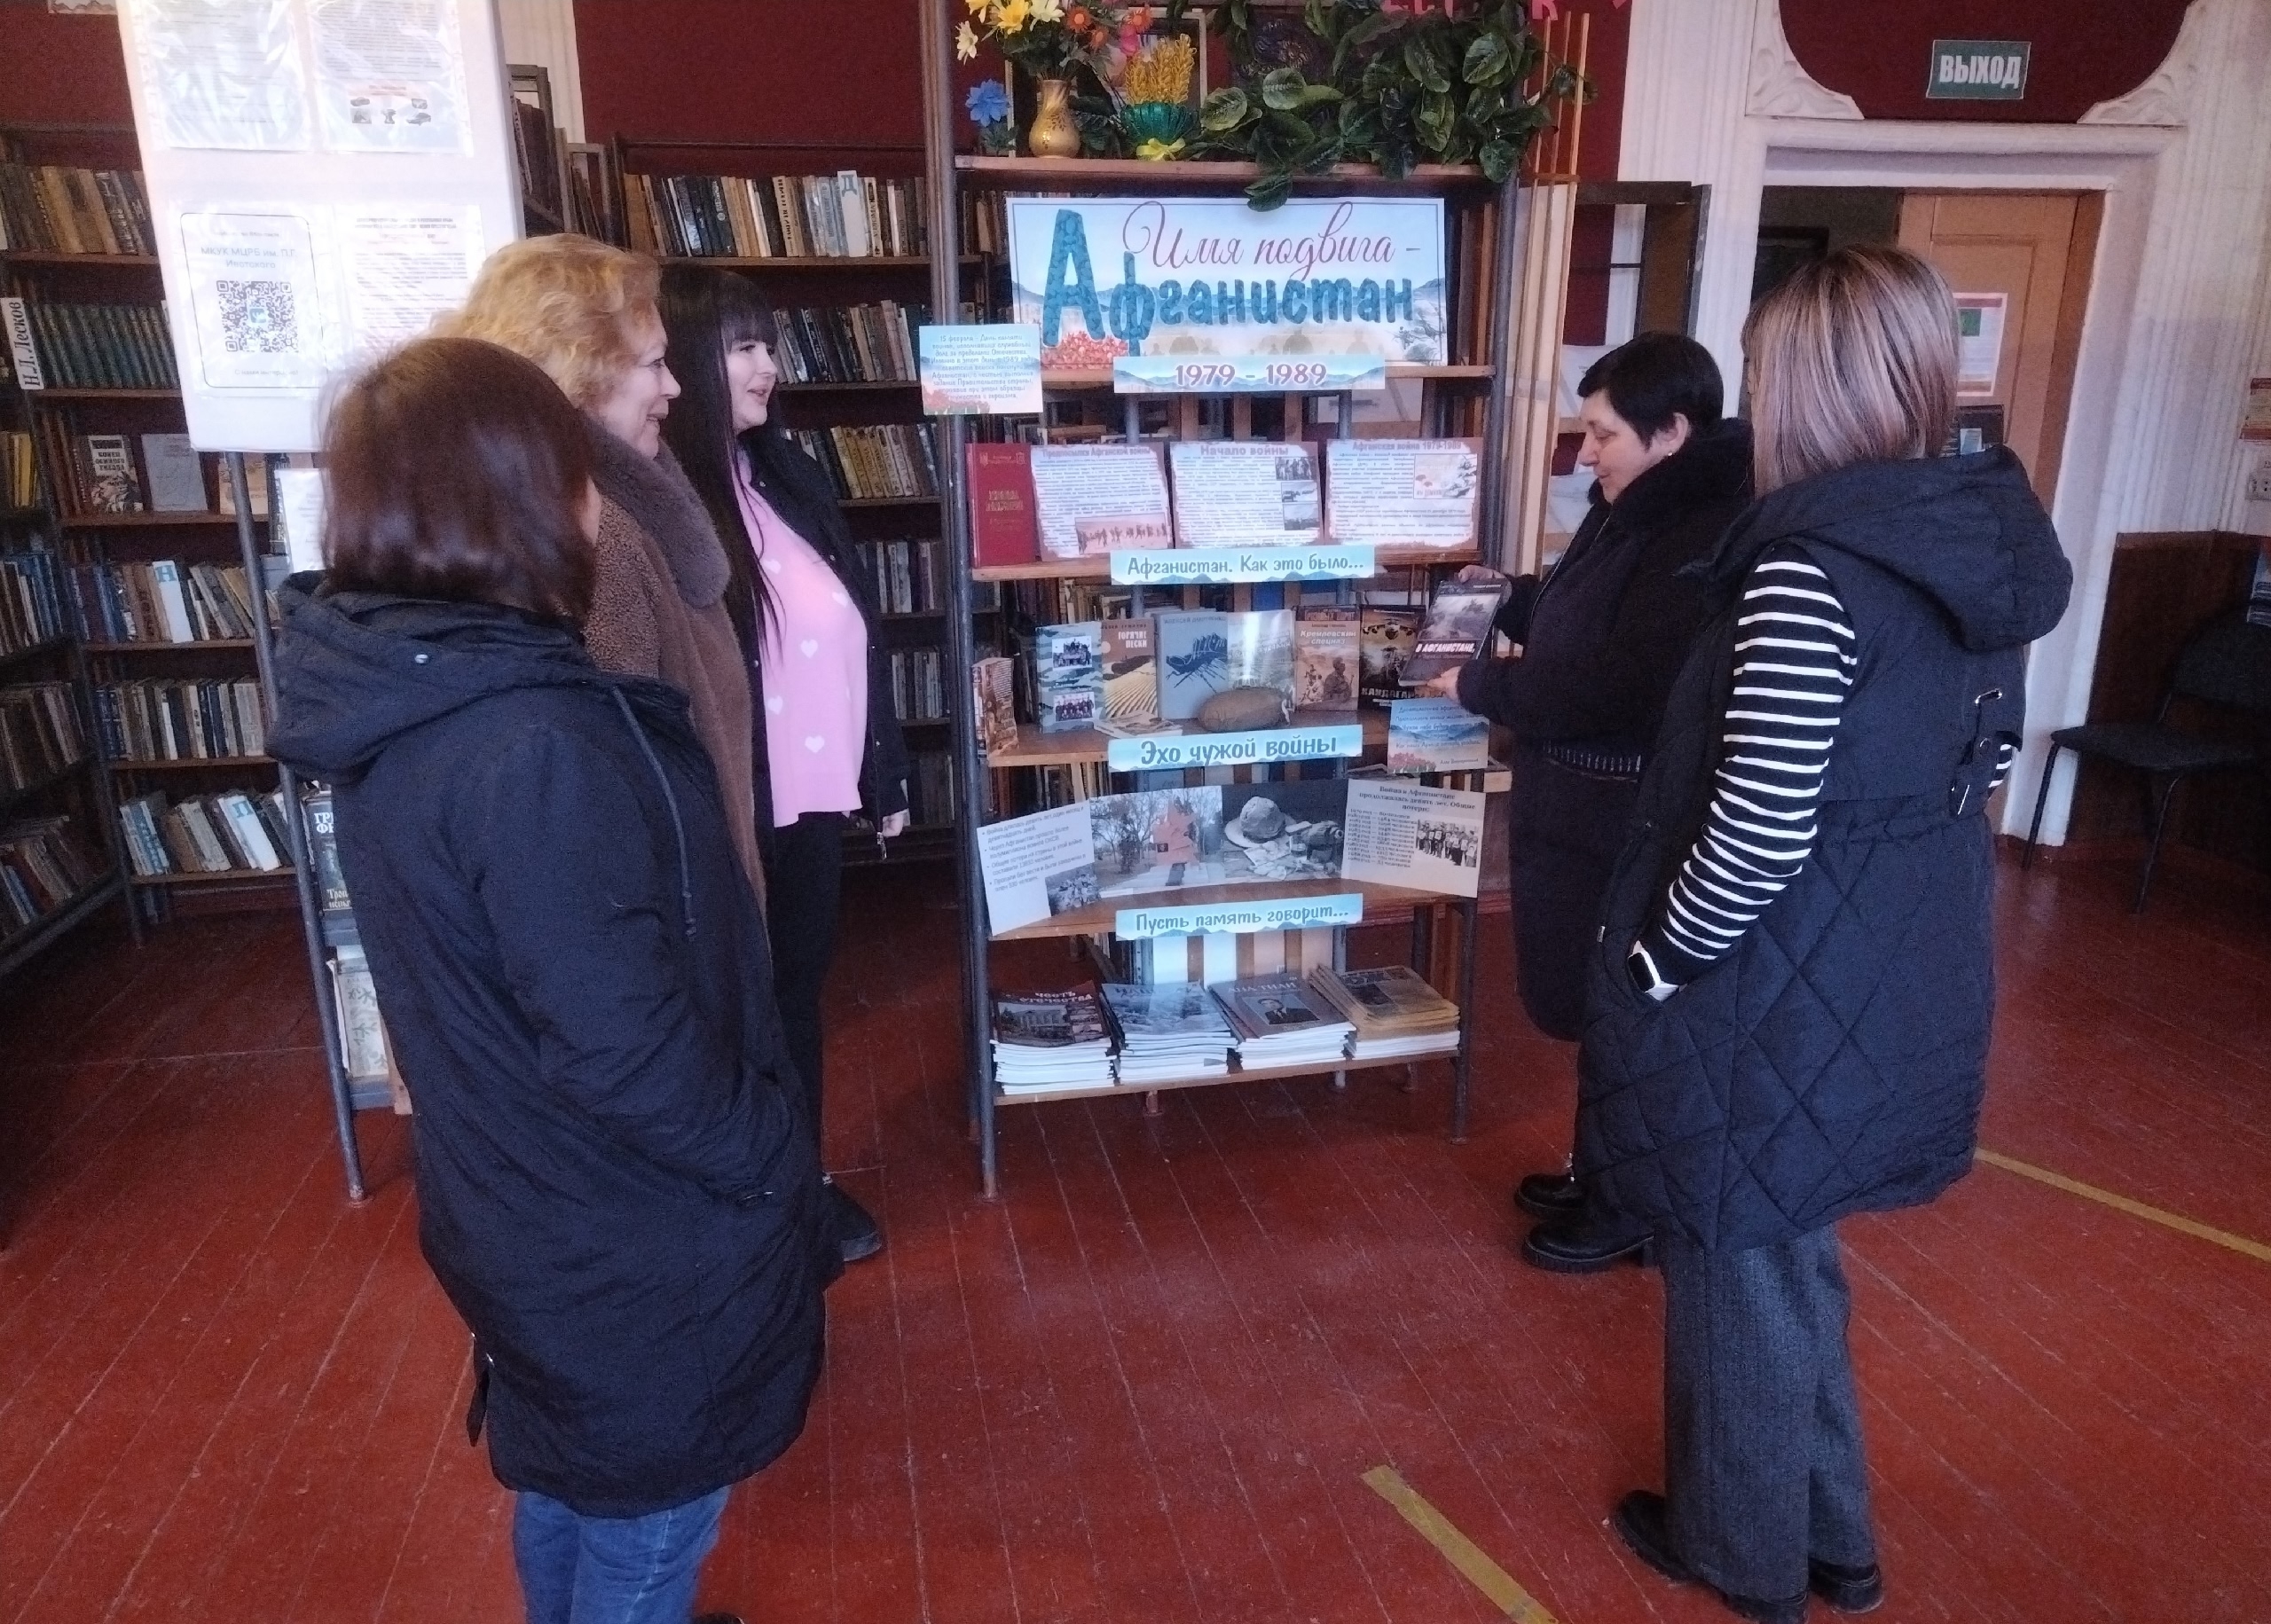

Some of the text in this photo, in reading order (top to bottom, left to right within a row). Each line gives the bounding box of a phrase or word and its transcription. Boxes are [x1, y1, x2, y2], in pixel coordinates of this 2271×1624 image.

[1939, 55, 2022, 89] ВЫХОД
[841, 175, 857, 197] Д
[1122, 200, 1244, 269] Имя
[1254, 200, 1395, 280] подвига
[200, 247, 229, 256] МКУК
[231, 247, 260, 257] МЦРБ
[1042, 208, 1414, 357] Афганистан
[9, 302, 32, 353] Лесков
[1175, 364, 1235, 386] 1979
[1266, 363, 1327, 386] 1989
[1200, 444, 1288, 456] Начало войны
[1352, 442, 1395, 454] Афганская
[155, 564, 178, 582] Н
[1128, 553, 1364, 579] Афганистан. Как это было...
[1118, 631, 1147, 640] ГОРЯЧИЕ
[1126, 639, 1147, 648] ПЕСКИ
[1415, 642, 1475, 654] В АФГАНИСТАНЕ,
[1141, 734, 1337, 766] Эхо чужой войны
[232, 801, 255, 818] П
[1136, 906, 1349, 935] Пусть память говорит...
